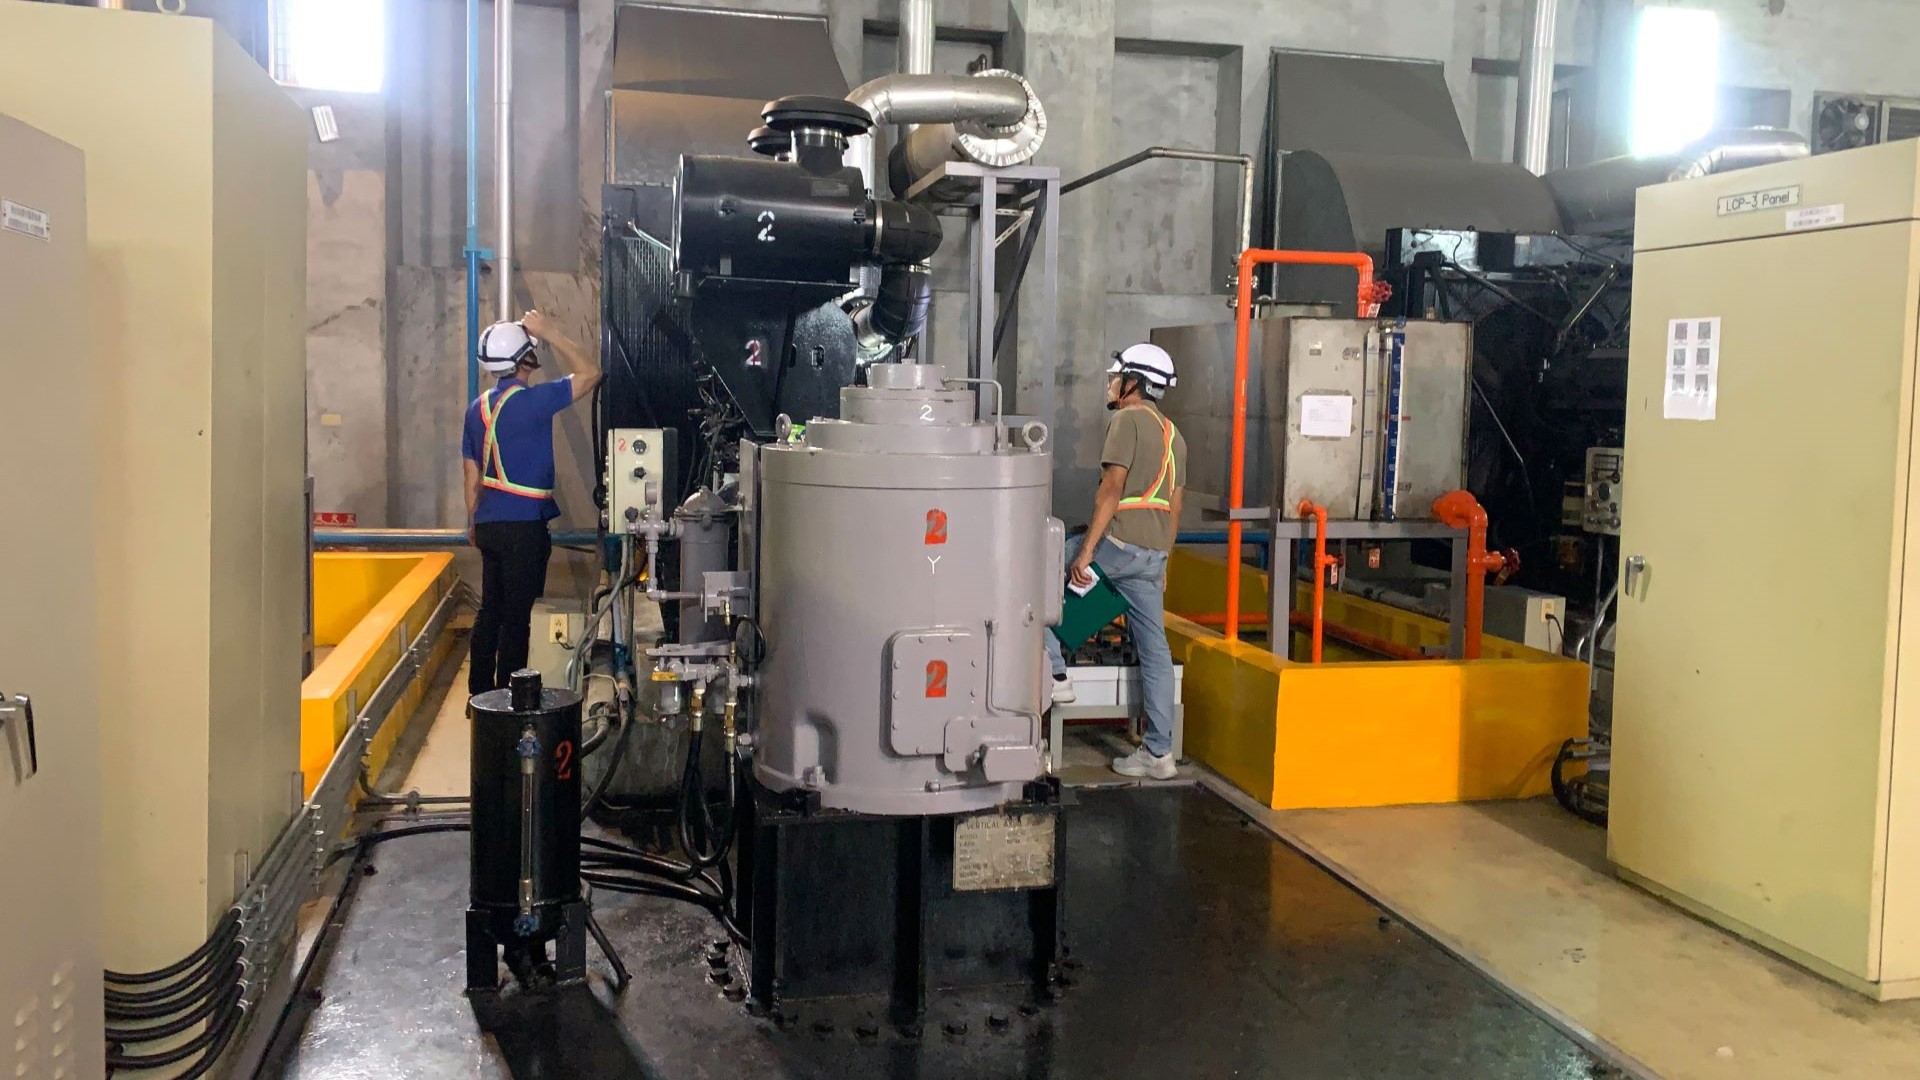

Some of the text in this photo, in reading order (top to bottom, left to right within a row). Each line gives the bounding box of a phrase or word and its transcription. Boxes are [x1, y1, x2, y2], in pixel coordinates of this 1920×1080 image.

[1726, 190, 1790, 212] LCP-3 Panel
[757, 210, 776, 242] 2
[745, 339, 762, 366] 2
[919, 404, 936, 421] 2
[925, 508, 948, 545] 2
[927, 555, 941, 574] Y
[925, 660, 948, 698] 2
[555, 740, 572, 780] 2
